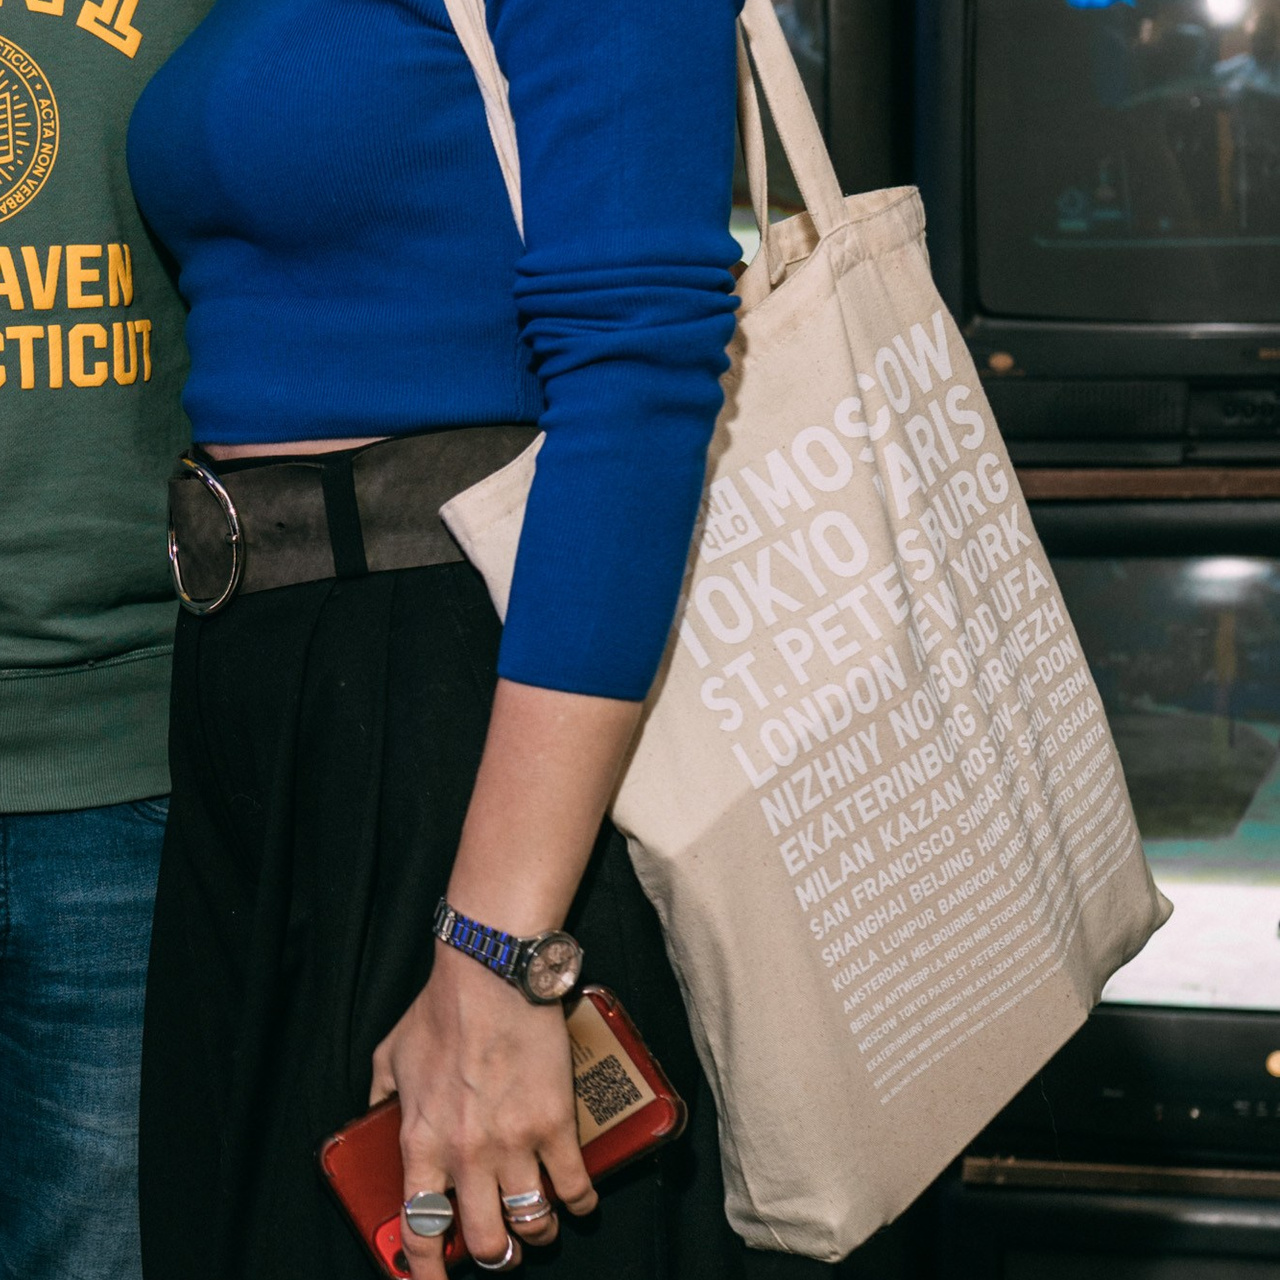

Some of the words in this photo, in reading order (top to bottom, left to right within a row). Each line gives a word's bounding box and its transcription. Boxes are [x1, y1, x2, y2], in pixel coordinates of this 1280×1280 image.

[33, 143, 52, 177] NON
[38, 98, 55, 139] ACTA
[738, 310, 952, 529] MOSCOW
[871, 384, 985, 523] ARIS
[700, 650, 787, 731] ST.
[770, 452, 1008, 691] PETESBURG
[730, 644, 906, 789] LONDON
[949, 503, 1032, 597] YORK
[759, 722, 882, 836] NIZHNY
[888, 603, 998, 749] NOVGOROD
[990, 557, 1049, 621] UFA
[778, 703, 976, 876] EKATERINBURG
[971, 595, 1064, 714] VORONEZH
[794, 836, 875, 912] MILAN
[877, 774, 965, 852] KAZAN
[809, 896, 851, 940] SAN
[850, 824, 955, 909] FRANCISCO
[956, 745, 1020, 835] SINGAPORE
[1047, 666, 1089, 714] PERM
[821, 893, 907, 968] SHANGHAI
[908, 847, 974, 904] BEIJING
[976, 811, 1010, 856] HONG
[1056, 696, 1099, 743] OSAKA
[831, 949, 880, 992] KUALA
[879, 908, 937, 955] LUMPUR
[937, 861, 998, 915] BANGKOK
[998, 800, 1043, 869] BARCEONA
[1041, 761, 1066, 805] SDNEY
[1066, 721, 1105, 770] JAKARTA
[843, 955, 908, 1014] AMSTERDAM
[910, 907, 977, 962] MELBOURNE
[975, 877, 1017, 915] MANILA
[1014, 852, 1034, 882] DELH
[1074, 743, 1110, 791] VANCOUVER
[849, 1000, 885, 1034] BERLIN
[885, 966, 930, 1008] ANTWERP
[944, 947, 959, 963] HO
[957, 935, 974, 954] CHI
[972, 923, 991, 943] MIN
[989, 882, 1036, 930] STOCKHOLM
[857, 1015, 897, 1054] MOSCOW
[897, 993, 928, 1020] TOKYO
[927, 974, 956, 1000] PARIS
[955, 964, 970, 980] ST.
[969, 920, 1028, 969] PETERSBURG
